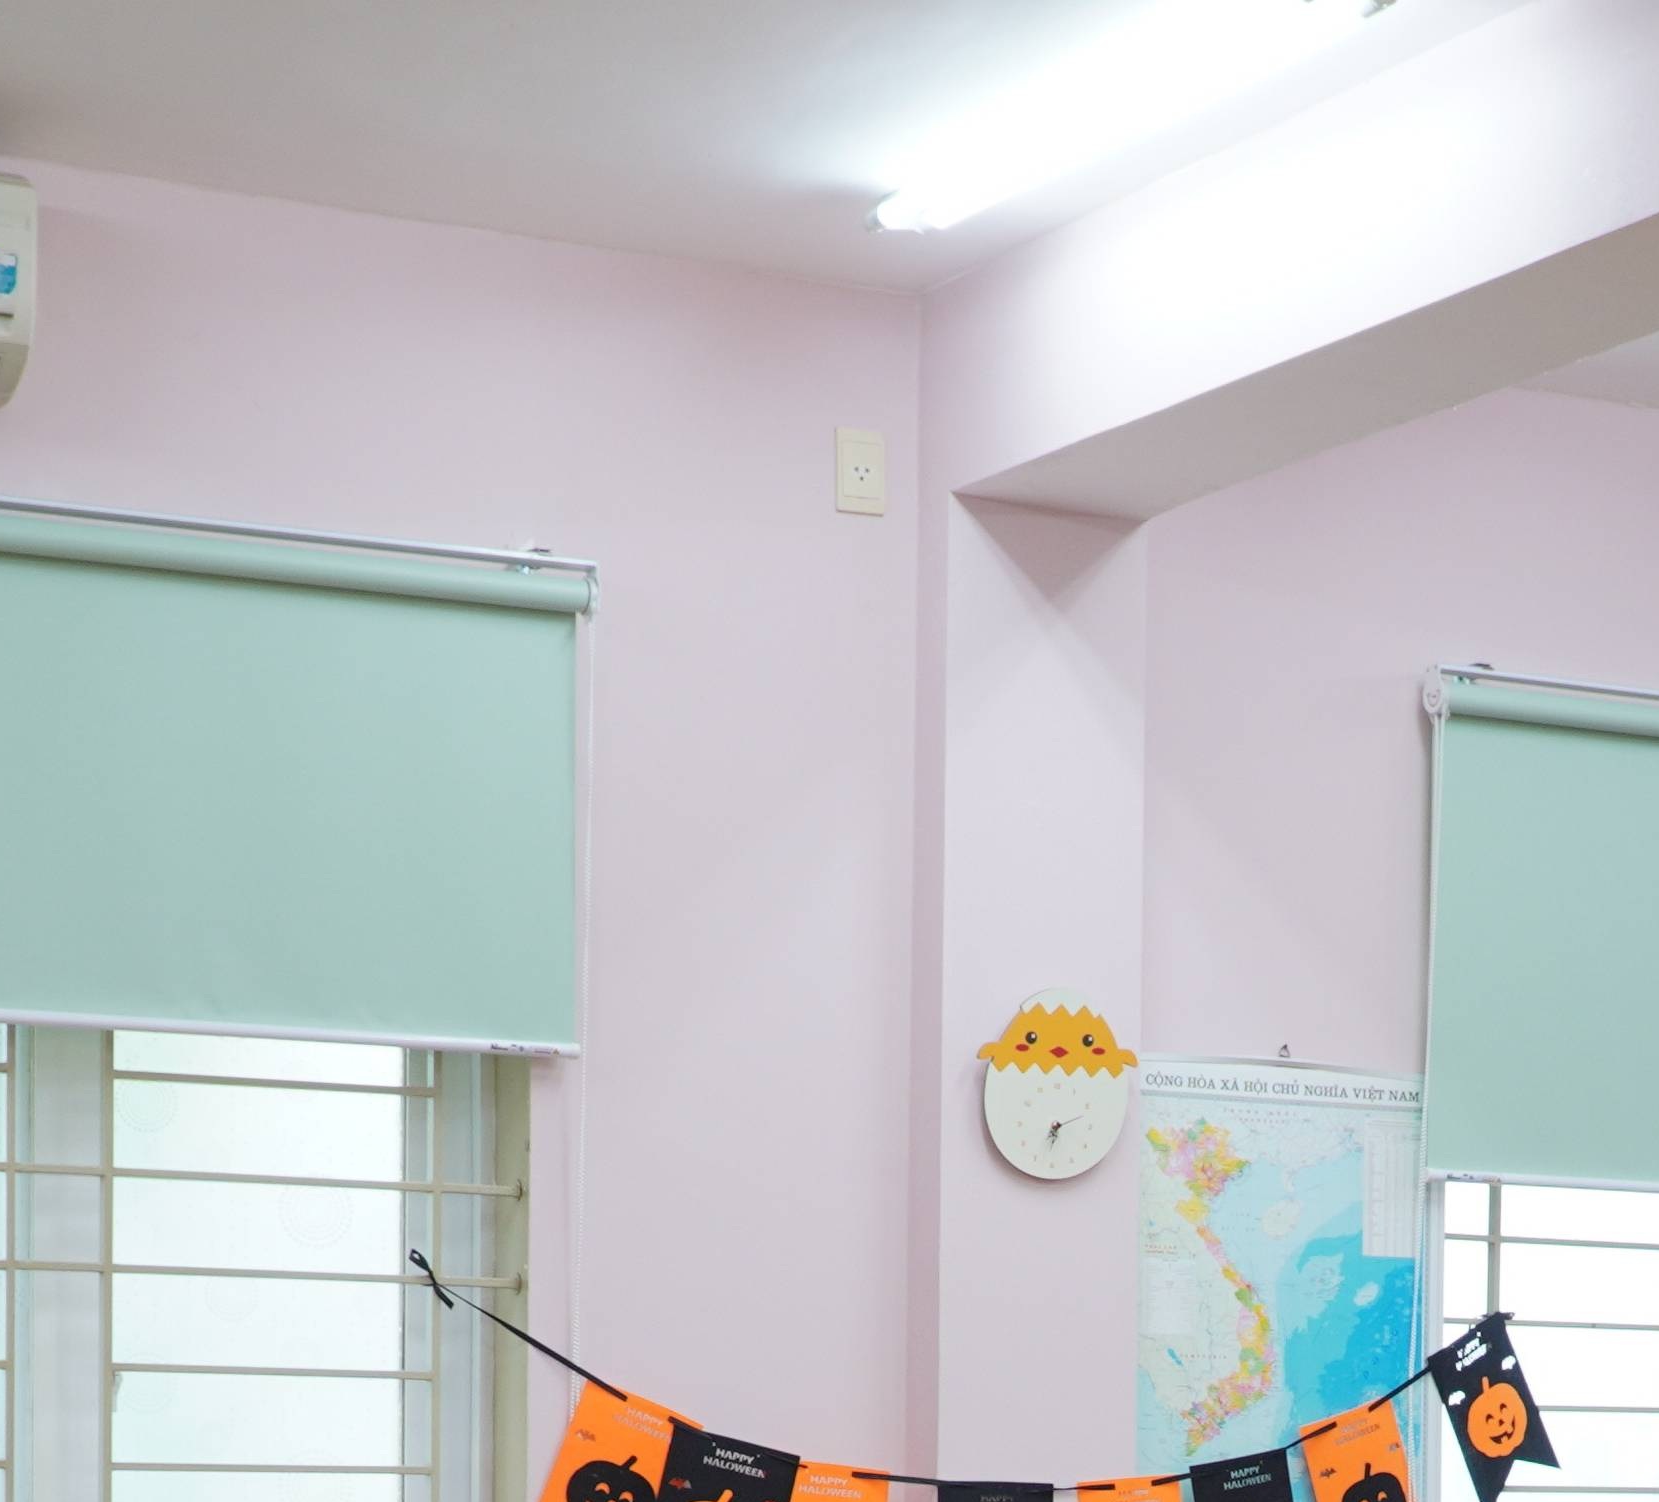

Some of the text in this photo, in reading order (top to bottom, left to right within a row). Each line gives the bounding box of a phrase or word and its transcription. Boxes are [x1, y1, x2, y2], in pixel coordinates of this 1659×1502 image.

[1145, 1071, 1183, 1087] CỘNG
[1188, 1075, 1216, 1090] HÒA
[1244, 1080, 1268, 1094] HỘI
[1272, 1080, 1300, 1095] CHỦ
[1304, 1084, 1348, 1098] NGHĨA
[1353, 1085, 1385, 1102] VIỆT
[1388, 1090, 1420, 1102] NAM
[626, 1406, 664, 1427] HAPPY
[716, 1448, 755, 1465] HAPPY
[703, 1456, 770, 1479] HALOWEEN
[1230, 1465, 1260, 1479] HAPPY
[809, 1475, 848, 1486] HAPPY
[1223, 1473, 1272, 1490] HALOWEEN
